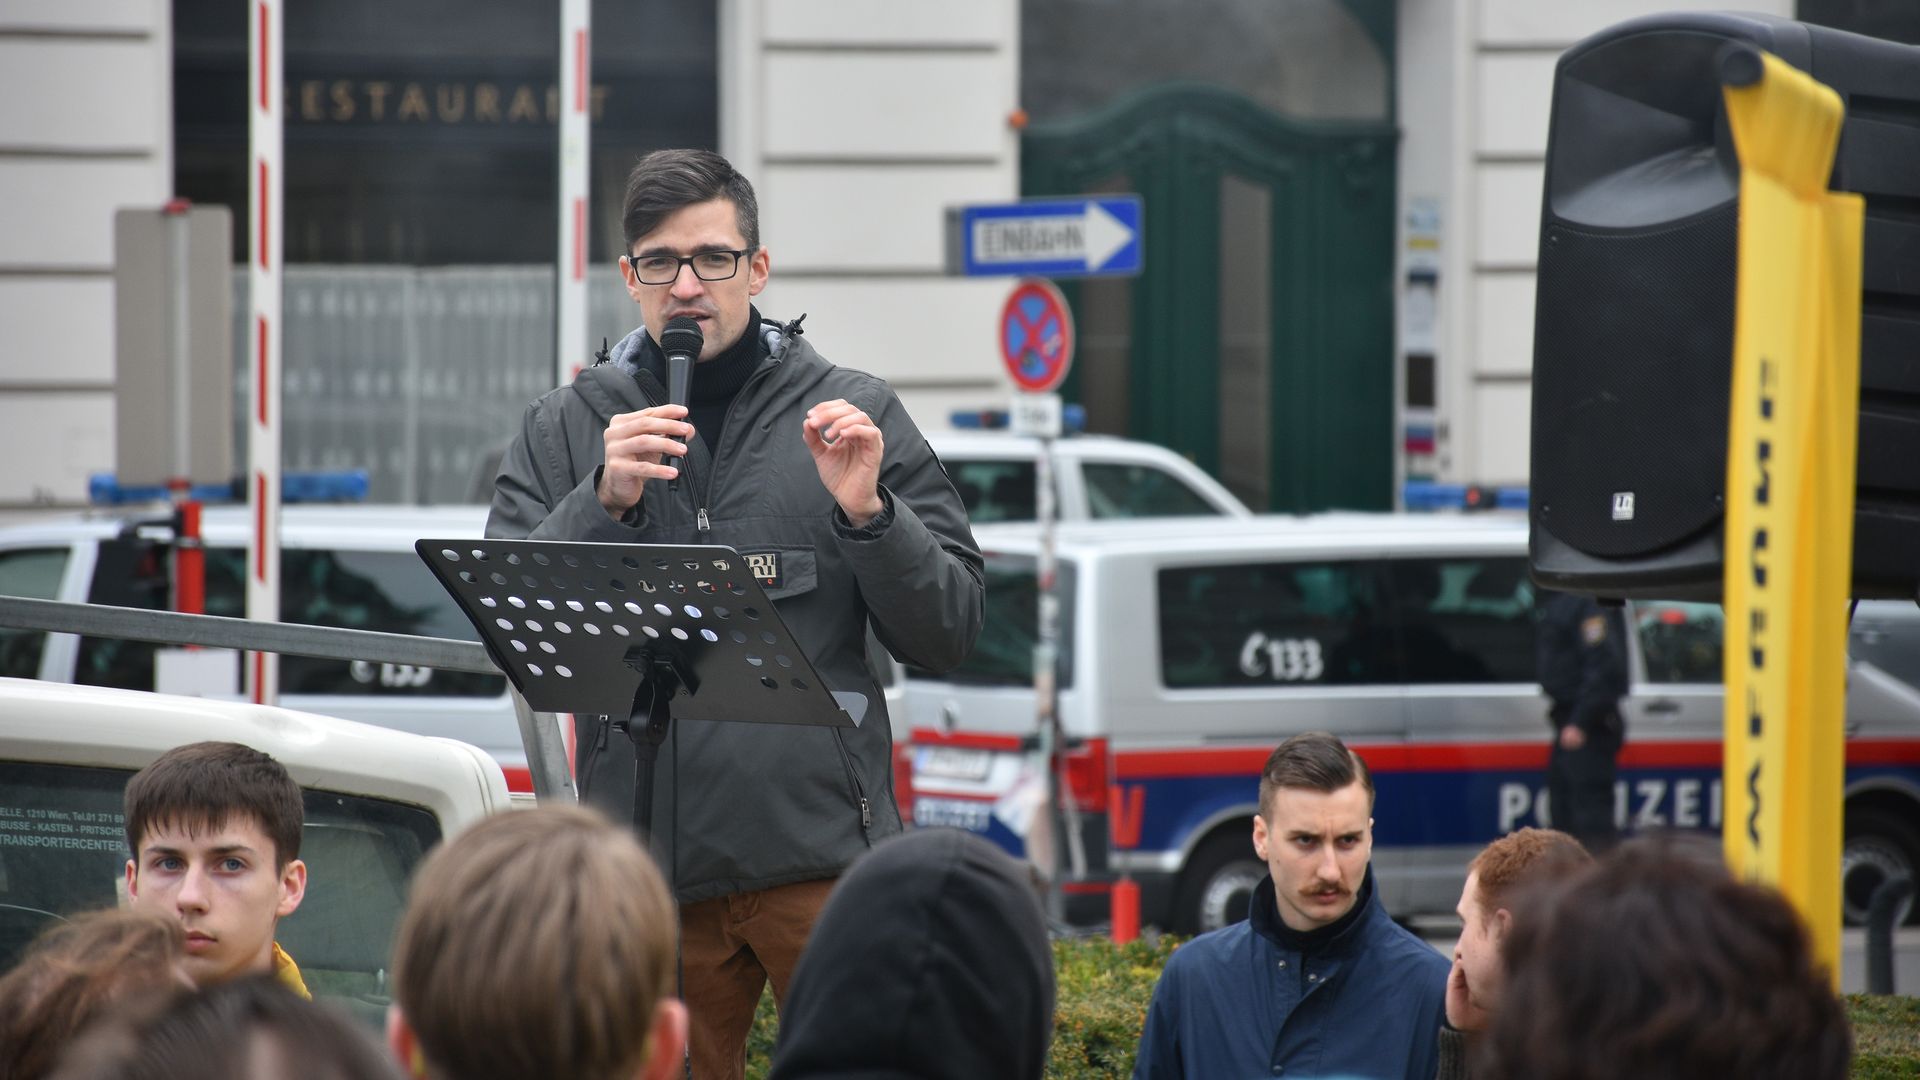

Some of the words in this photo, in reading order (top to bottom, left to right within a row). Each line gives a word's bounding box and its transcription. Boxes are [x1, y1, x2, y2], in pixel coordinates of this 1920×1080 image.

[284, 80, 612, 123] ESTAURAT
[1266, 639, 1324, 680] 133
[26, 808, 46, 818] 1210
[1498, 779, 1724, 832] PIZEI
[38, 822, 73, 833] KASTEN
[80, 825, 127, 837] PRITSCHE
